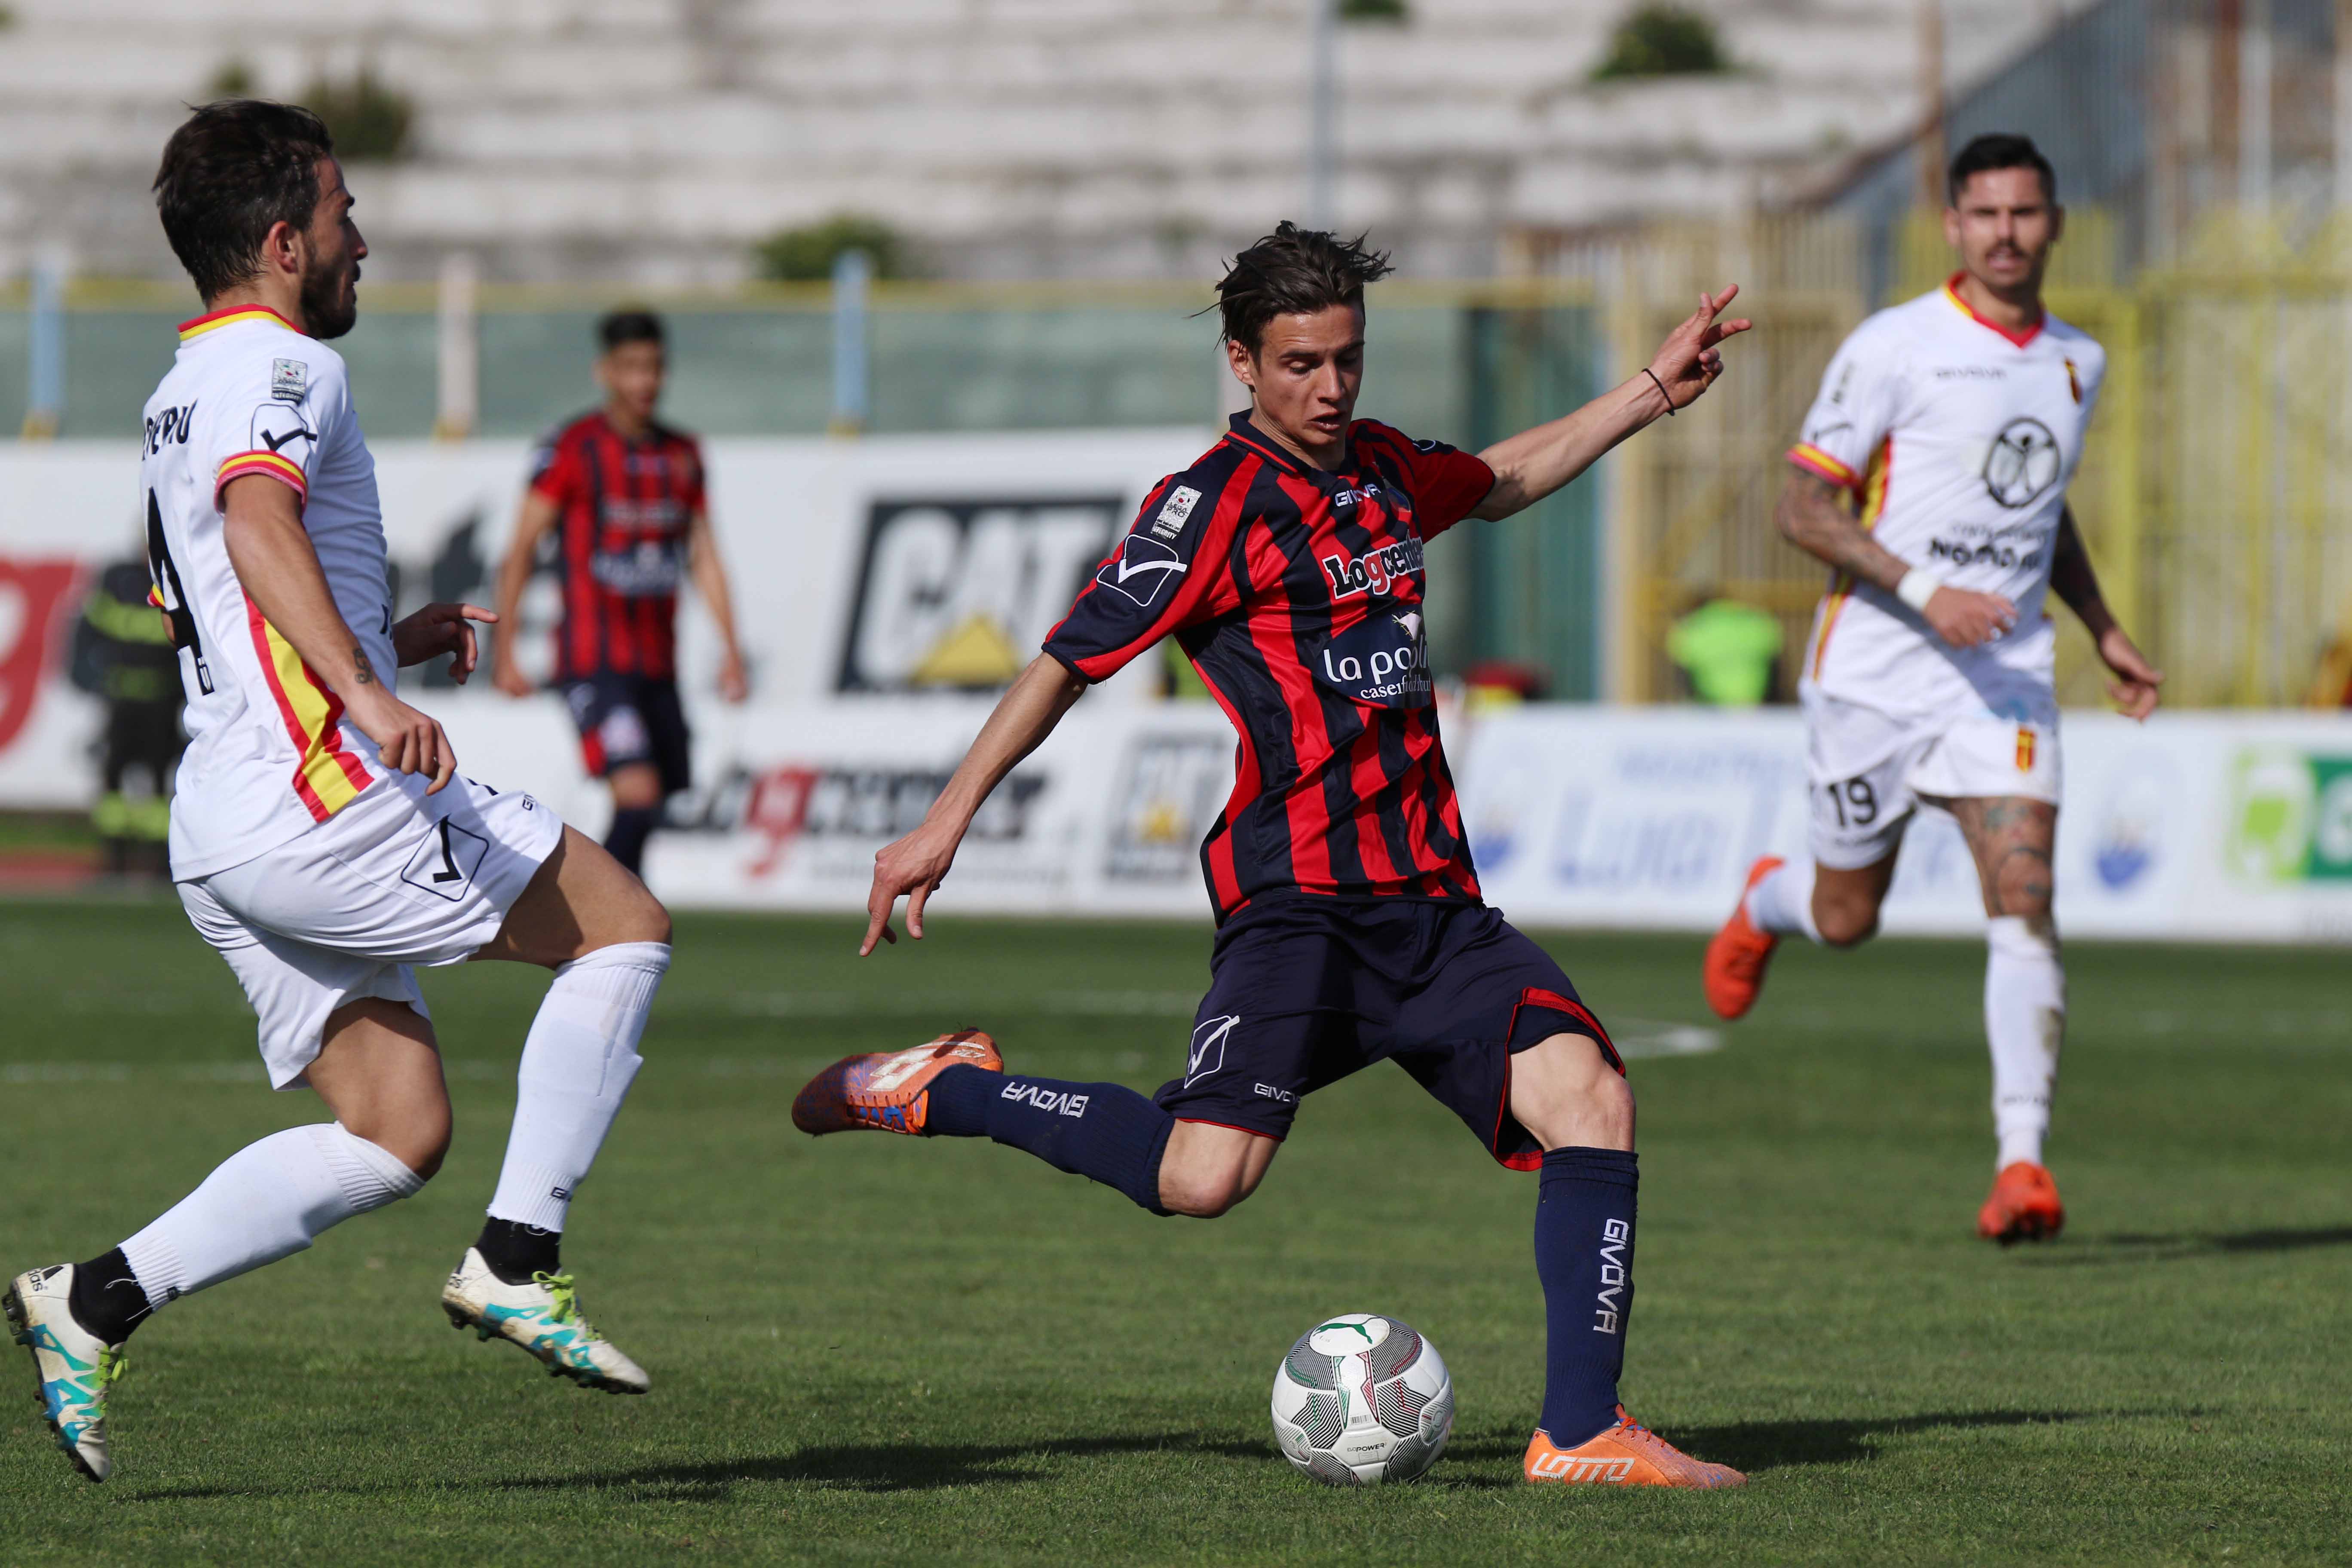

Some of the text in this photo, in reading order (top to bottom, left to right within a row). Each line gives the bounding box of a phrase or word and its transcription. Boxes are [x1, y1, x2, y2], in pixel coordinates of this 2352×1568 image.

[1167, 506, 1185, 518] PRO
[1170, 502, 1187, 512] LEGA
[1324, 649, 1362, 683] la
[1828, 776, 1877, 828] 19
[1001, 1081, 1090, 1118] GIVOVA
[1254, 1083, 1300, 1104] GIVO
[1593, 1218, 1629, 1335] GIVOVA
